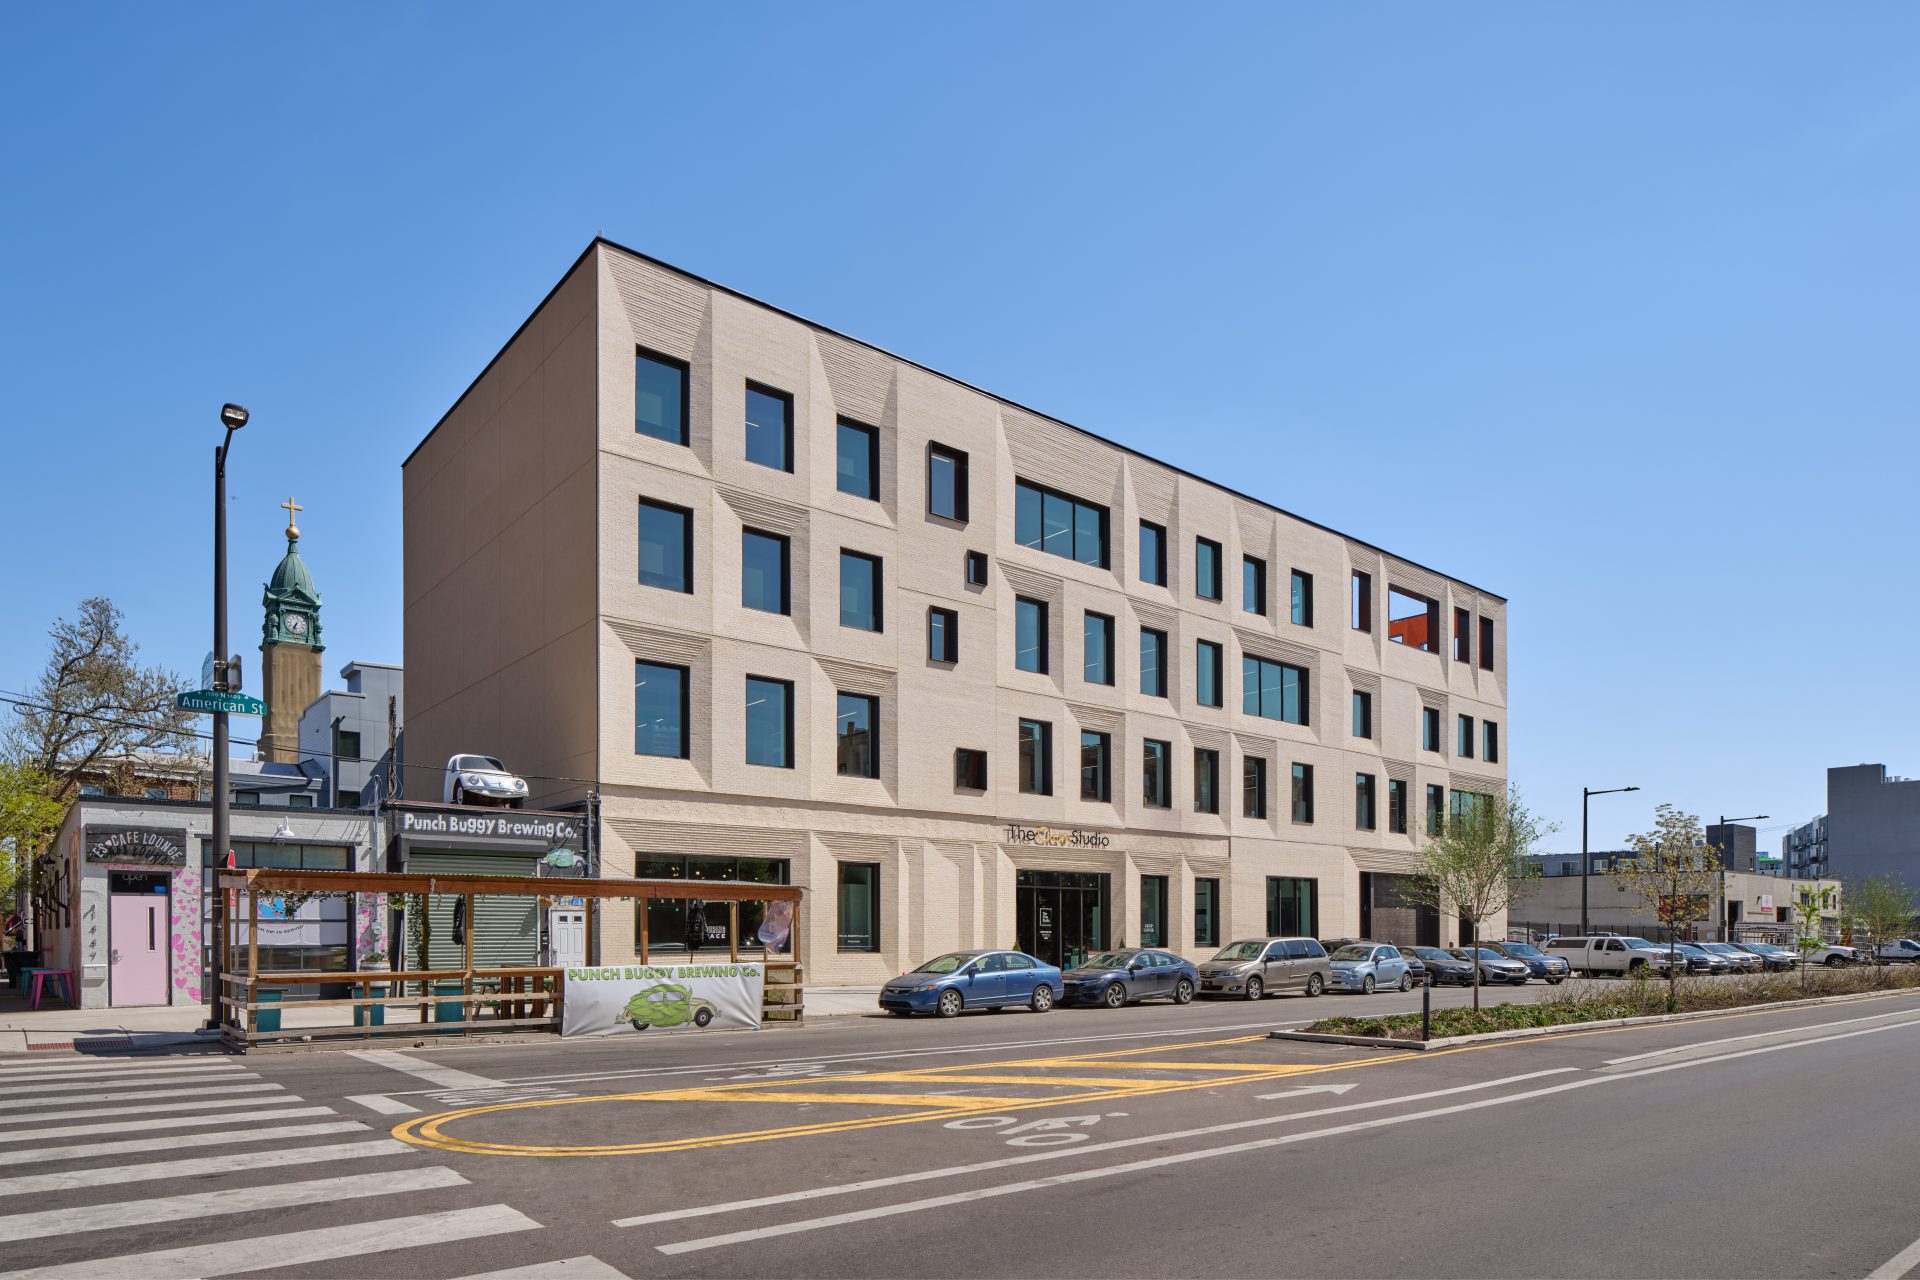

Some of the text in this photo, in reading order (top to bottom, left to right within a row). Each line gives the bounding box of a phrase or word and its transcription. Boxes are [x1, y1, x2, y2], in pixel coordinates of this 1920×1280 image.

[182, 697, 264, 715] American St
[404, 813, 578, 839] Punch Buggy Brewing Co.
[1008, 823, 1036, 841] The
[1071, 829, 1110, 847] Studio
[111, 832, 139, 847] CAFE
[142, 832, 183, 860] LOUNGE
[568, 966, 761, 981] PUNCH BUGGY BREWING Co.
